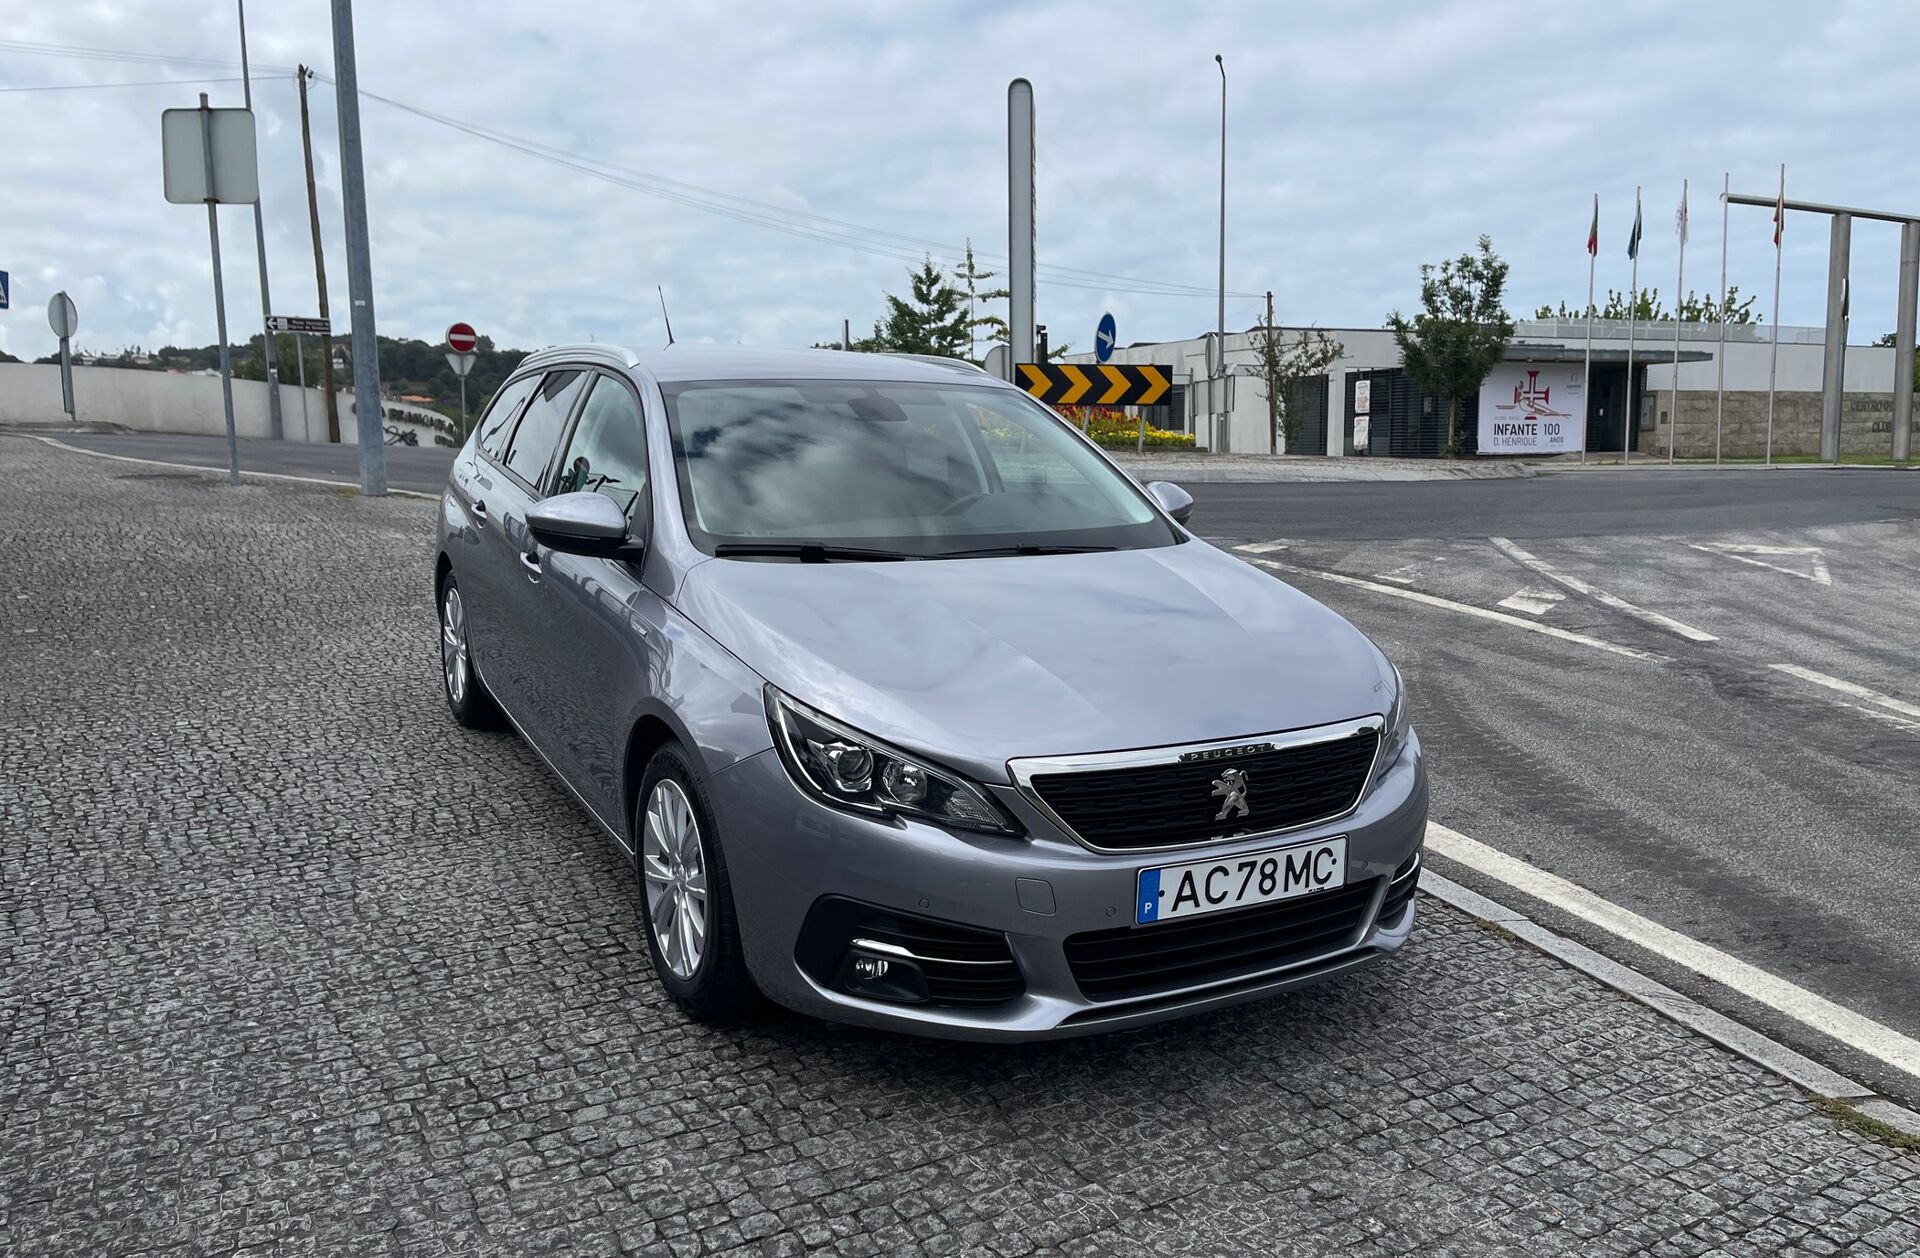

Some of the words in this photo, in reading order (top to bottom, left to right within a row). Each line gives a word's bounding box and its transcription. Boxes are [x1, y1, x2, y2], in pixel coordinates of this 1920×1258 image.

[1494, 424, 1537, 435] INFANTE
[1543, 424, 1560, 435] 100
[1493, 438, 1500, 446] D.
[1502, 437, 1537, 446] HENRIQUE
[1190, 744, 1265, 761] PEUGEOT
[1144, 902, 1153, 914] P
